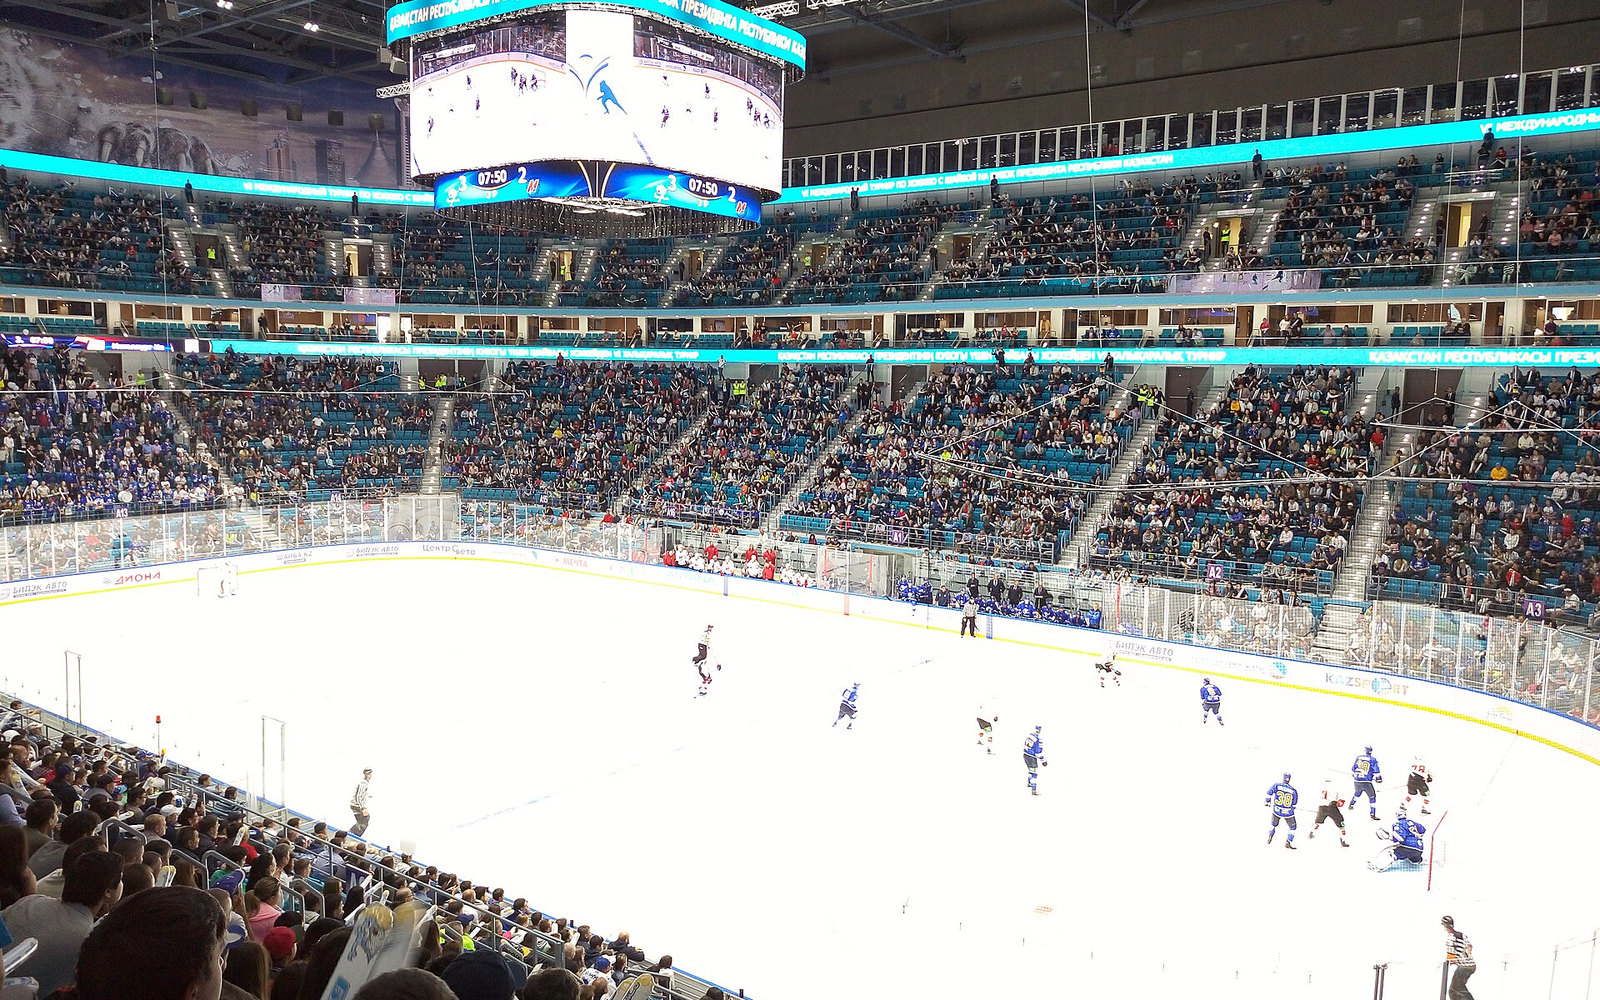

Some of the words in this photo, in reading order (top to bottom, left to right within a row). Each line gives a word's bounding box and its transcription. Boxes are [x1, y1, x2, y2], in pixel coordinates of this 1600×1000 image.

[477, 169, 508, 185] 07:50
[517, 166, 528, 184] 2
[688, 177, 718, 196] 07:50
[728, 186, 736, 203] 2
[1368, 351, 1442, 364] ҚАЗАҚСТАН
[1444, 351, 1552, 363] РЕСПУБЛИКАСЫ
[115, 508, 129, 518] A13
[893, 532, 903, 543] A1
[114, 571, 161, 585] ДИОНА
[1209, 566, 1221, 579] A2
[13, 583, 43, 594] БИПЭК
[45, 581, 68, 591] АВТО
[1525, 602, 1542, 617] A3
[1115, 640, 1147, 654] БИПЭК
[1148, 644, 1174, 657] АВТО
[1275, 791, 1293, 808] 38
